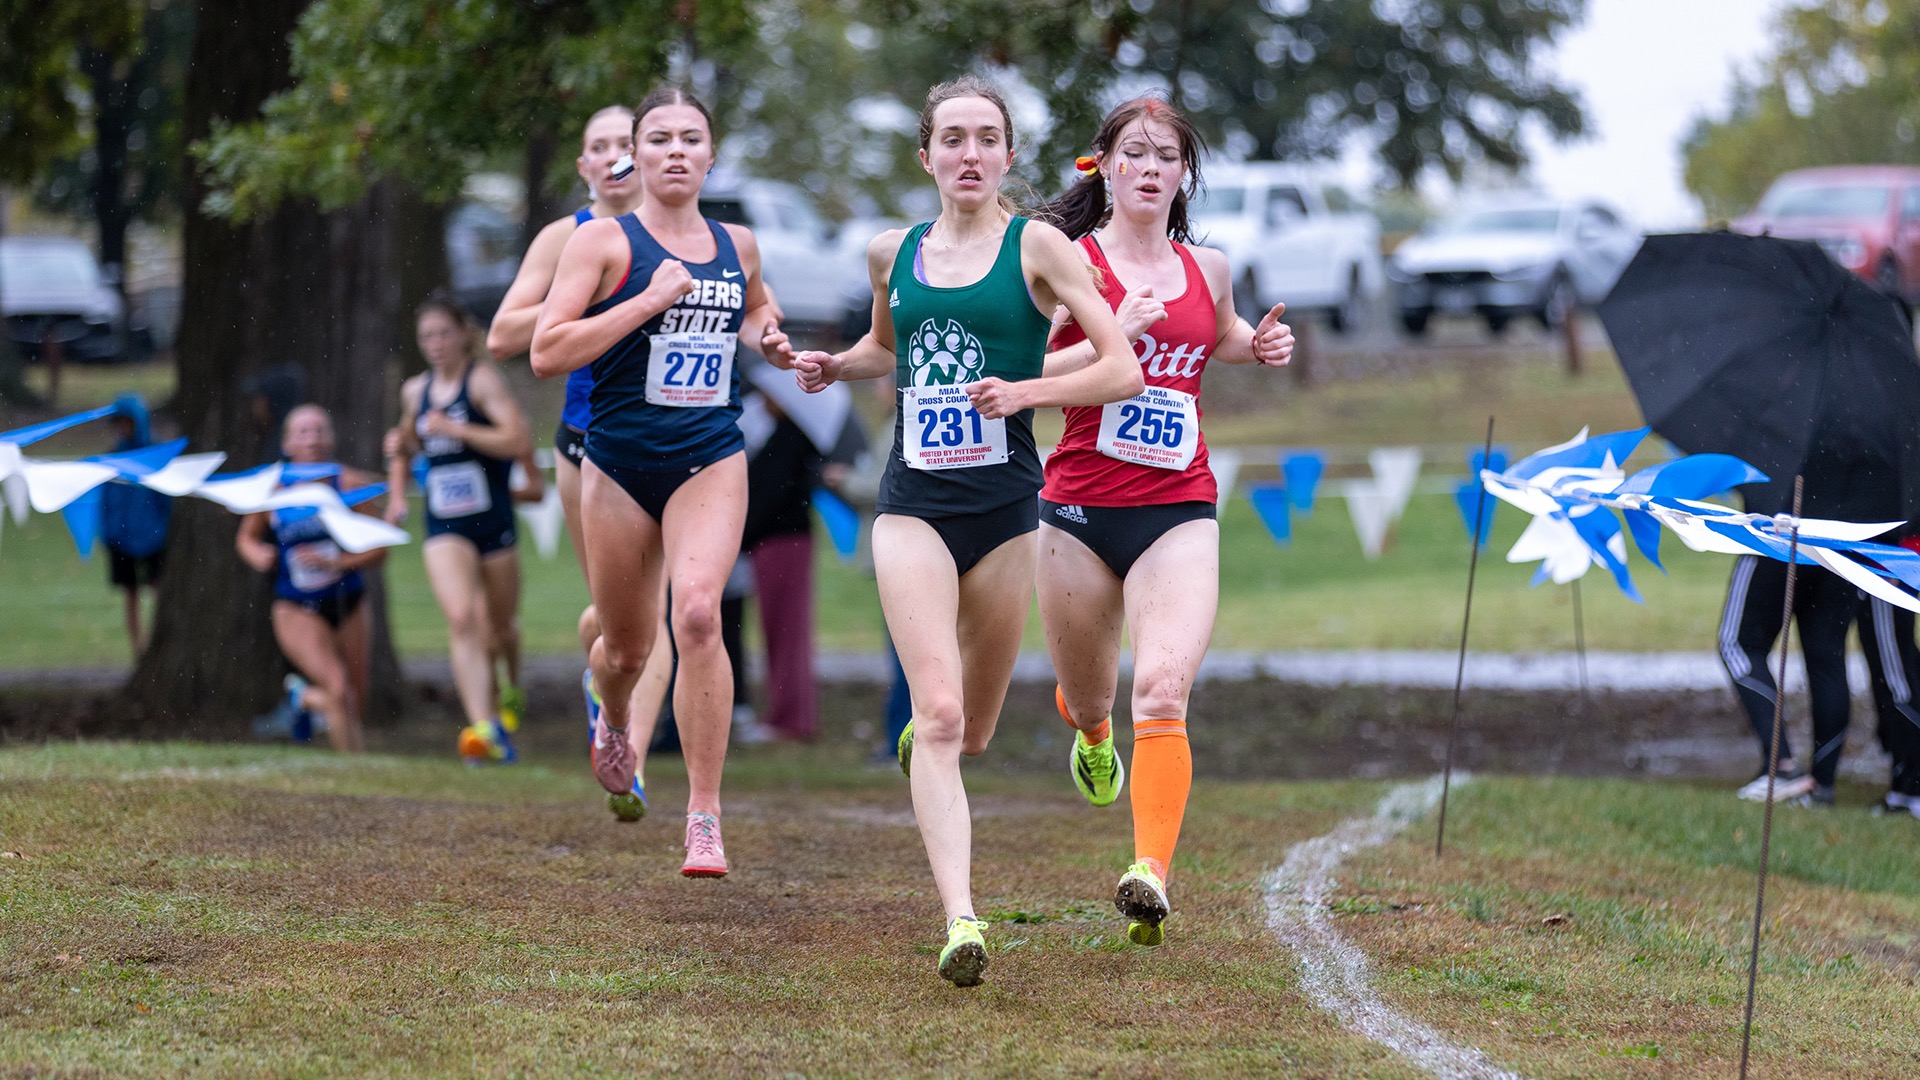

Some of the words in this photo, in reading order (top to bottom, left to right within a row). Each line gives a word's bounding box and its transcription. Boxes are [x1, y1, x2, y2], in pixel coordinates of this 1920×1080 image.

[673, 279, 742, 309] GERS
[659, 308, 733, 334] STATE
[663, 351, 722, 388] 278
[924, 363, 959, 386] N
[938, 388, 960, 396] MIAA
[1147, 389, 1168, 398] MIAA
[918, 396, 943, 406] CROSS
[945, 395, 971, 404] COUN
[1152, 397, 1184, 409] COUNTRY
[918, 407, 983, 448] 231
[1116, 404, 1185, 448] 255
[919, 450, 942, 458] HOSTED
[954, 446, 992, 456] PITTSBURG
[1112, 441, 1137, 451] HOSTED
[1138, 444, 1148, 453] BY
[1148, 447, 1183, 459] PITTSBURG
[1118, 449, 1138, 458] STATE
[1139, 452, 1176, 464] UNIVERSITY
[926, 456, 945, 465] STATE
[946, 454, 986, 464] UNIVERSITY
[1055, 508, 1088, 524] adidas
